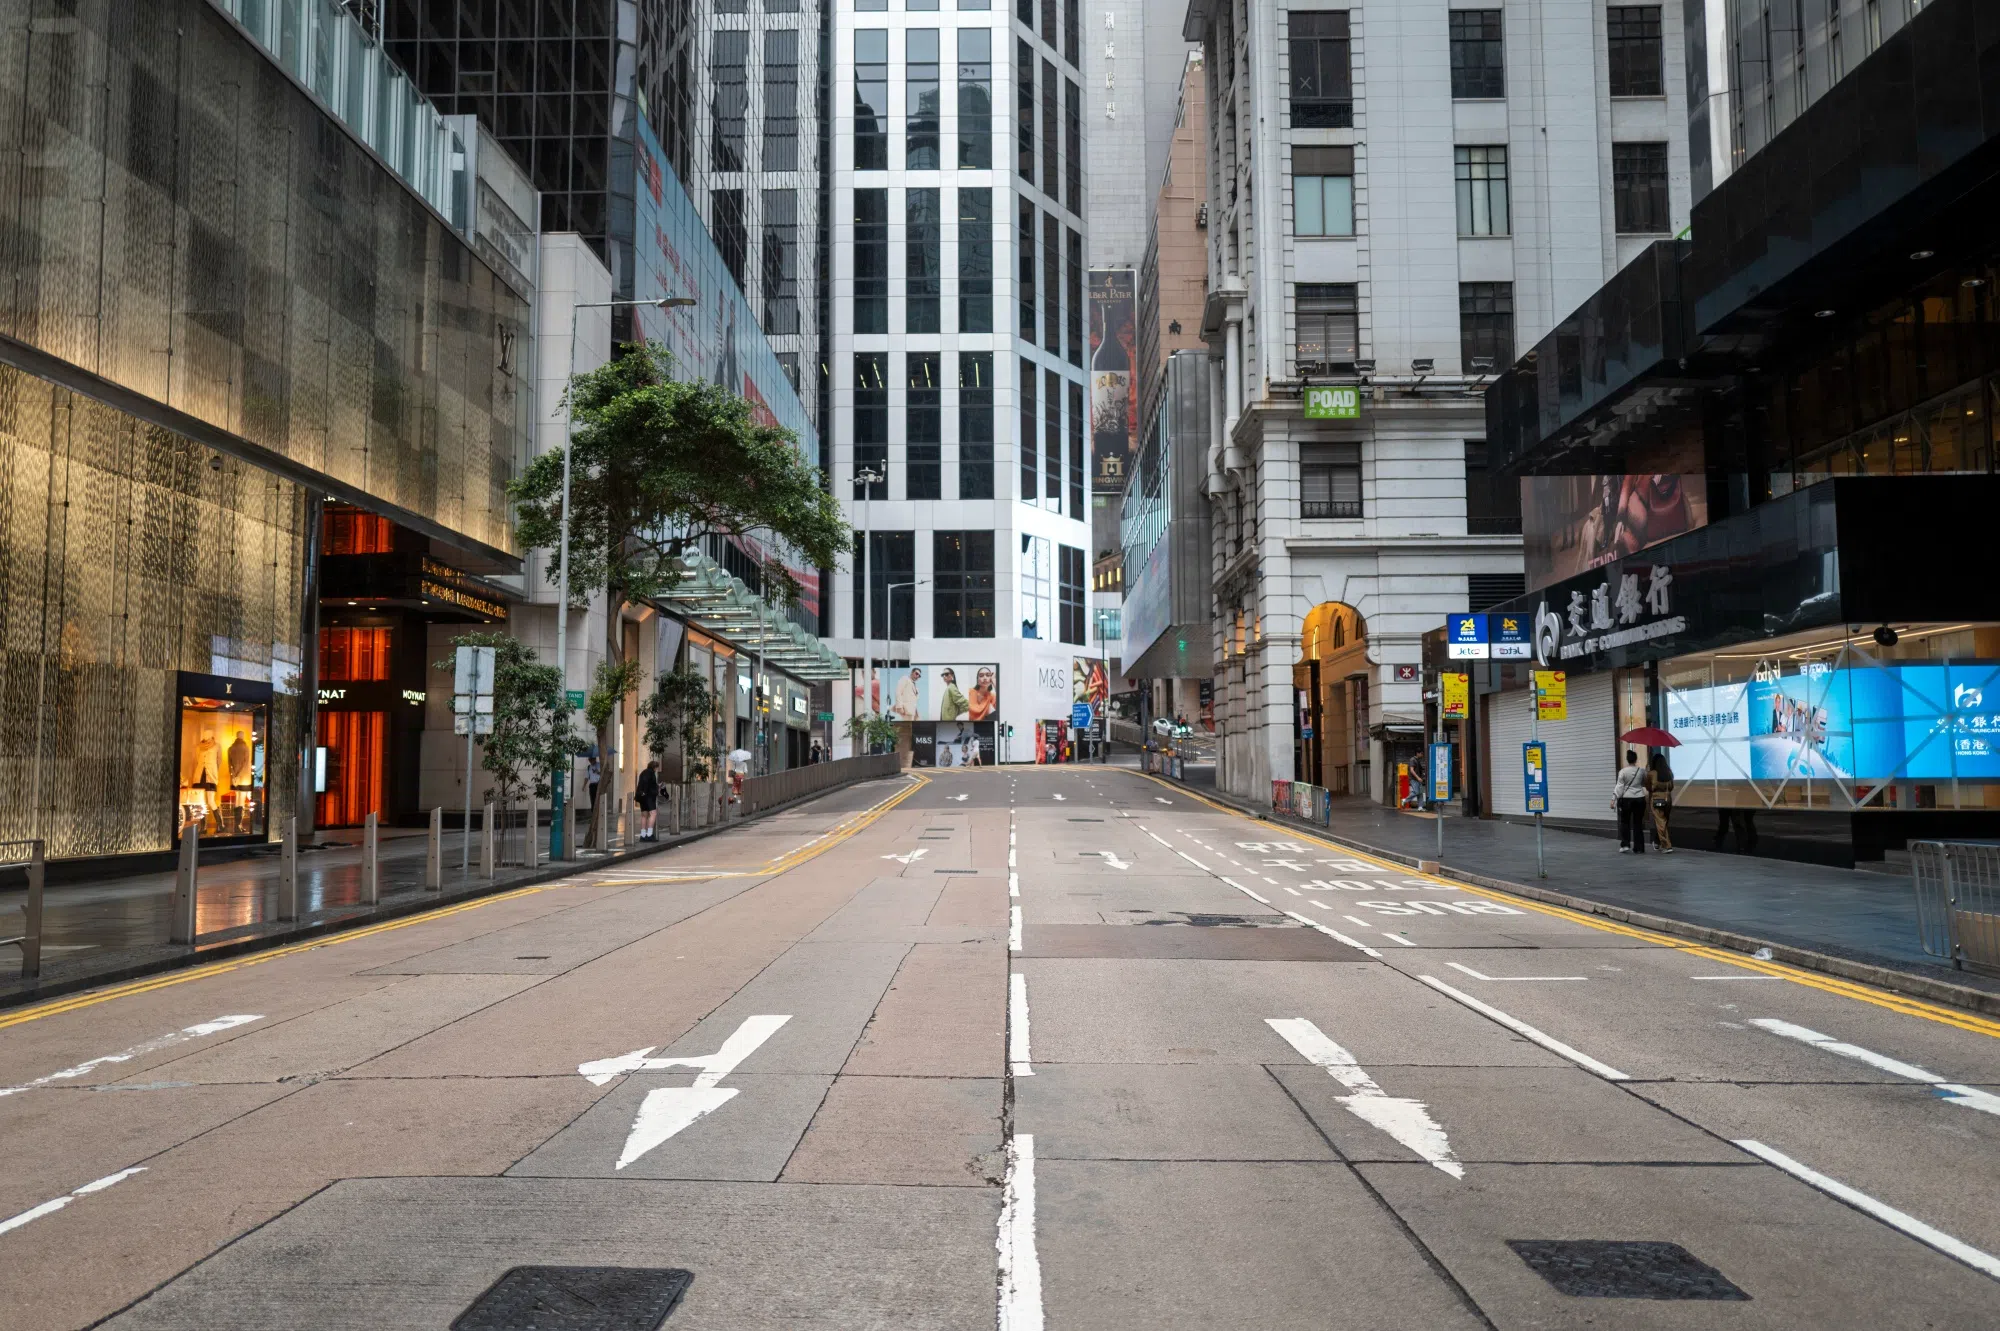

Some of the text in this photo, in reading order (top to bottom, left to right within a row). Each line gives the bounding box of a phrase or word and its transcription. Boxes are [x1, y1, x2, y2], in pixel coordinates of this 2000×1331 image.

[1309, 390, 1355, 407] POAD
[1566, 564, 1674, 638] 交通銀行
[1460, 617, 1475, 631] 24
[1560, 615, 1686, 660] BANK OF COMMUNICATIONS
[1038, 667, 1065, 689] M&S
[402, 689, 426, 701] MOYNAT
[915, 736, 933, 745] M&S
[1300, 879, 1460, 891] STOP
[1355, 900, 1528, 916] BUS
